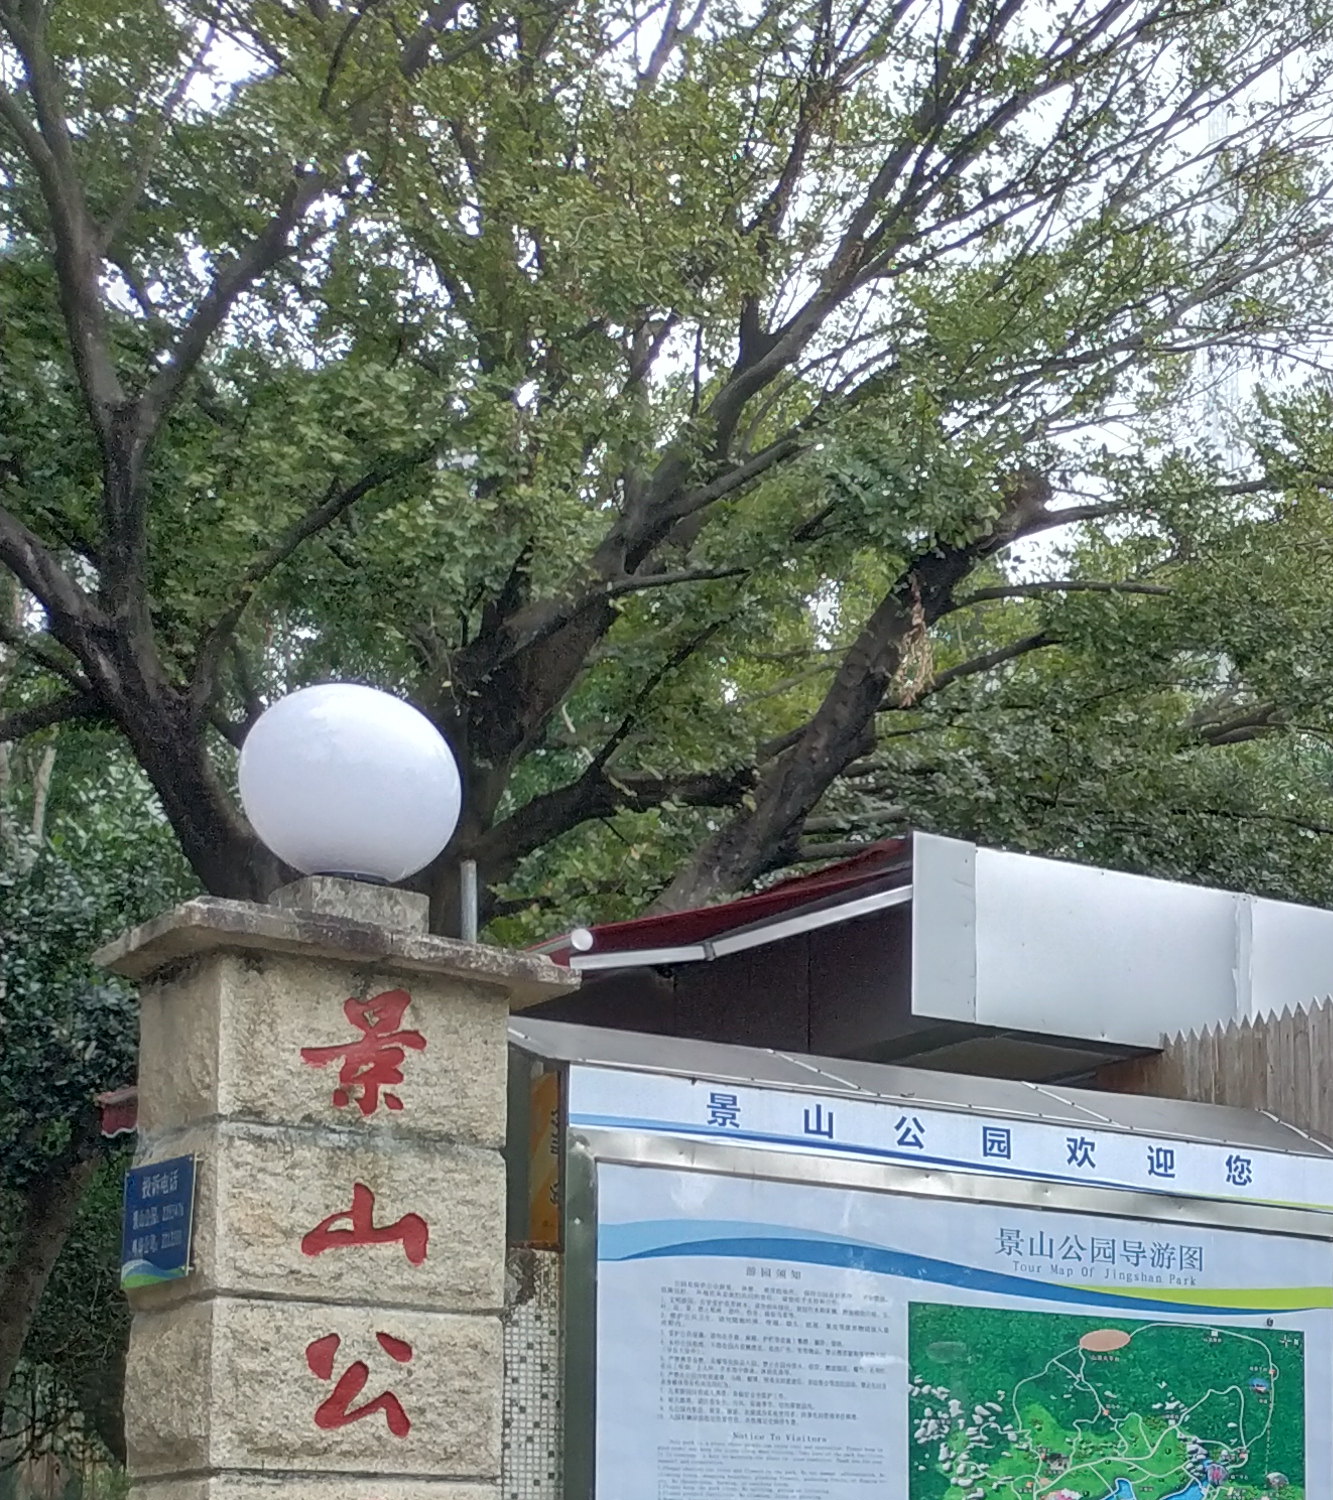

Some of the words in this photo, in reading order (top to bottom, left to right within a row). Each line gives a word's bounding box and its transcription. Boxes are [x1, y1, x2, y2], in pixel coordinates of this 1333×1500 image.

[705, 1092, 1254, 1187] 景山公园欢迎您
[995, 1227, 1204, 1272] 景山公园导游图
[1012, 1260, 1042, 1274] Tour
[1050, 1264, 1074, 1278] Map
[1104, 1267, 1163, 1284] Jingshan
[1168, 1273, 1198, 1286] Park
[732, 1431, 766, 1442] Notice
